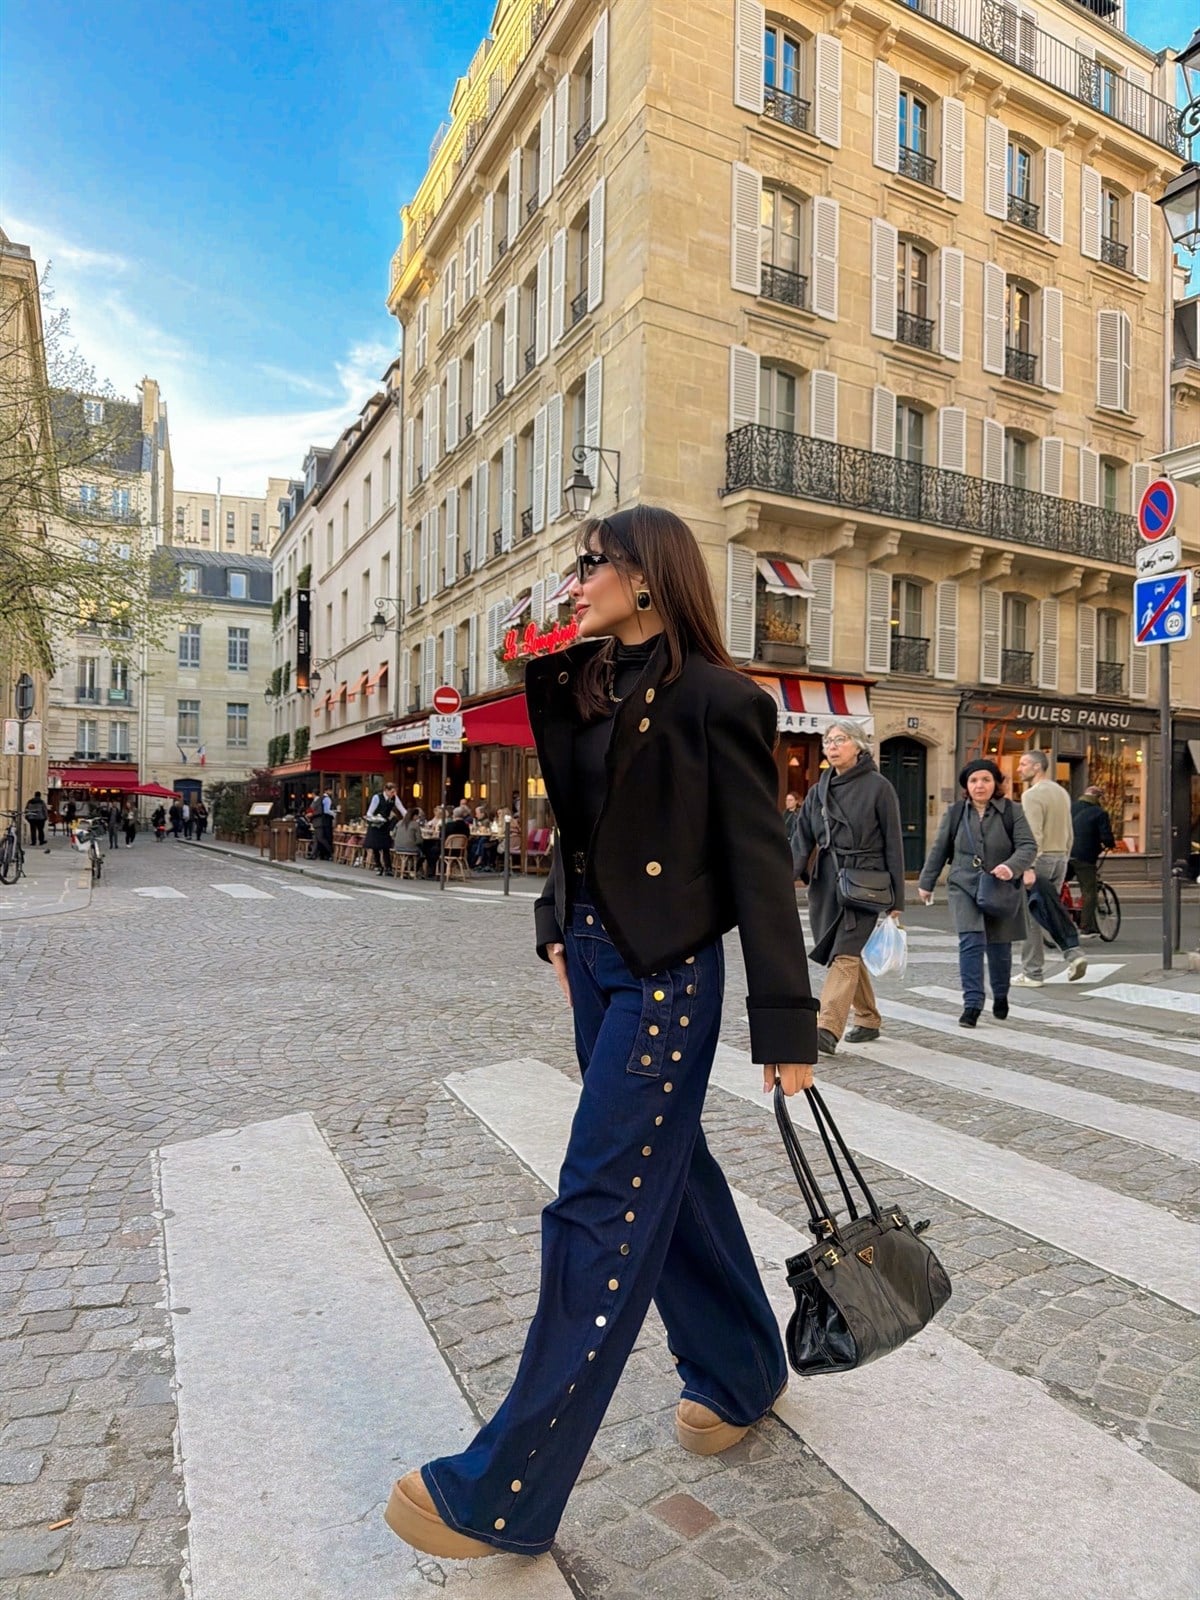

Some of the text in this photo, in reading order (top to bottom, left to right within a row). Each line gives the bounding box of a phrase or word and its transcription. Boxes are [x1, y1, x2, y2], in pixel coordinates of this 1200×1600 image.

[1169, 619, 1180, 628] 20
[1016, 704, 1131, 728] JULES PANSU
